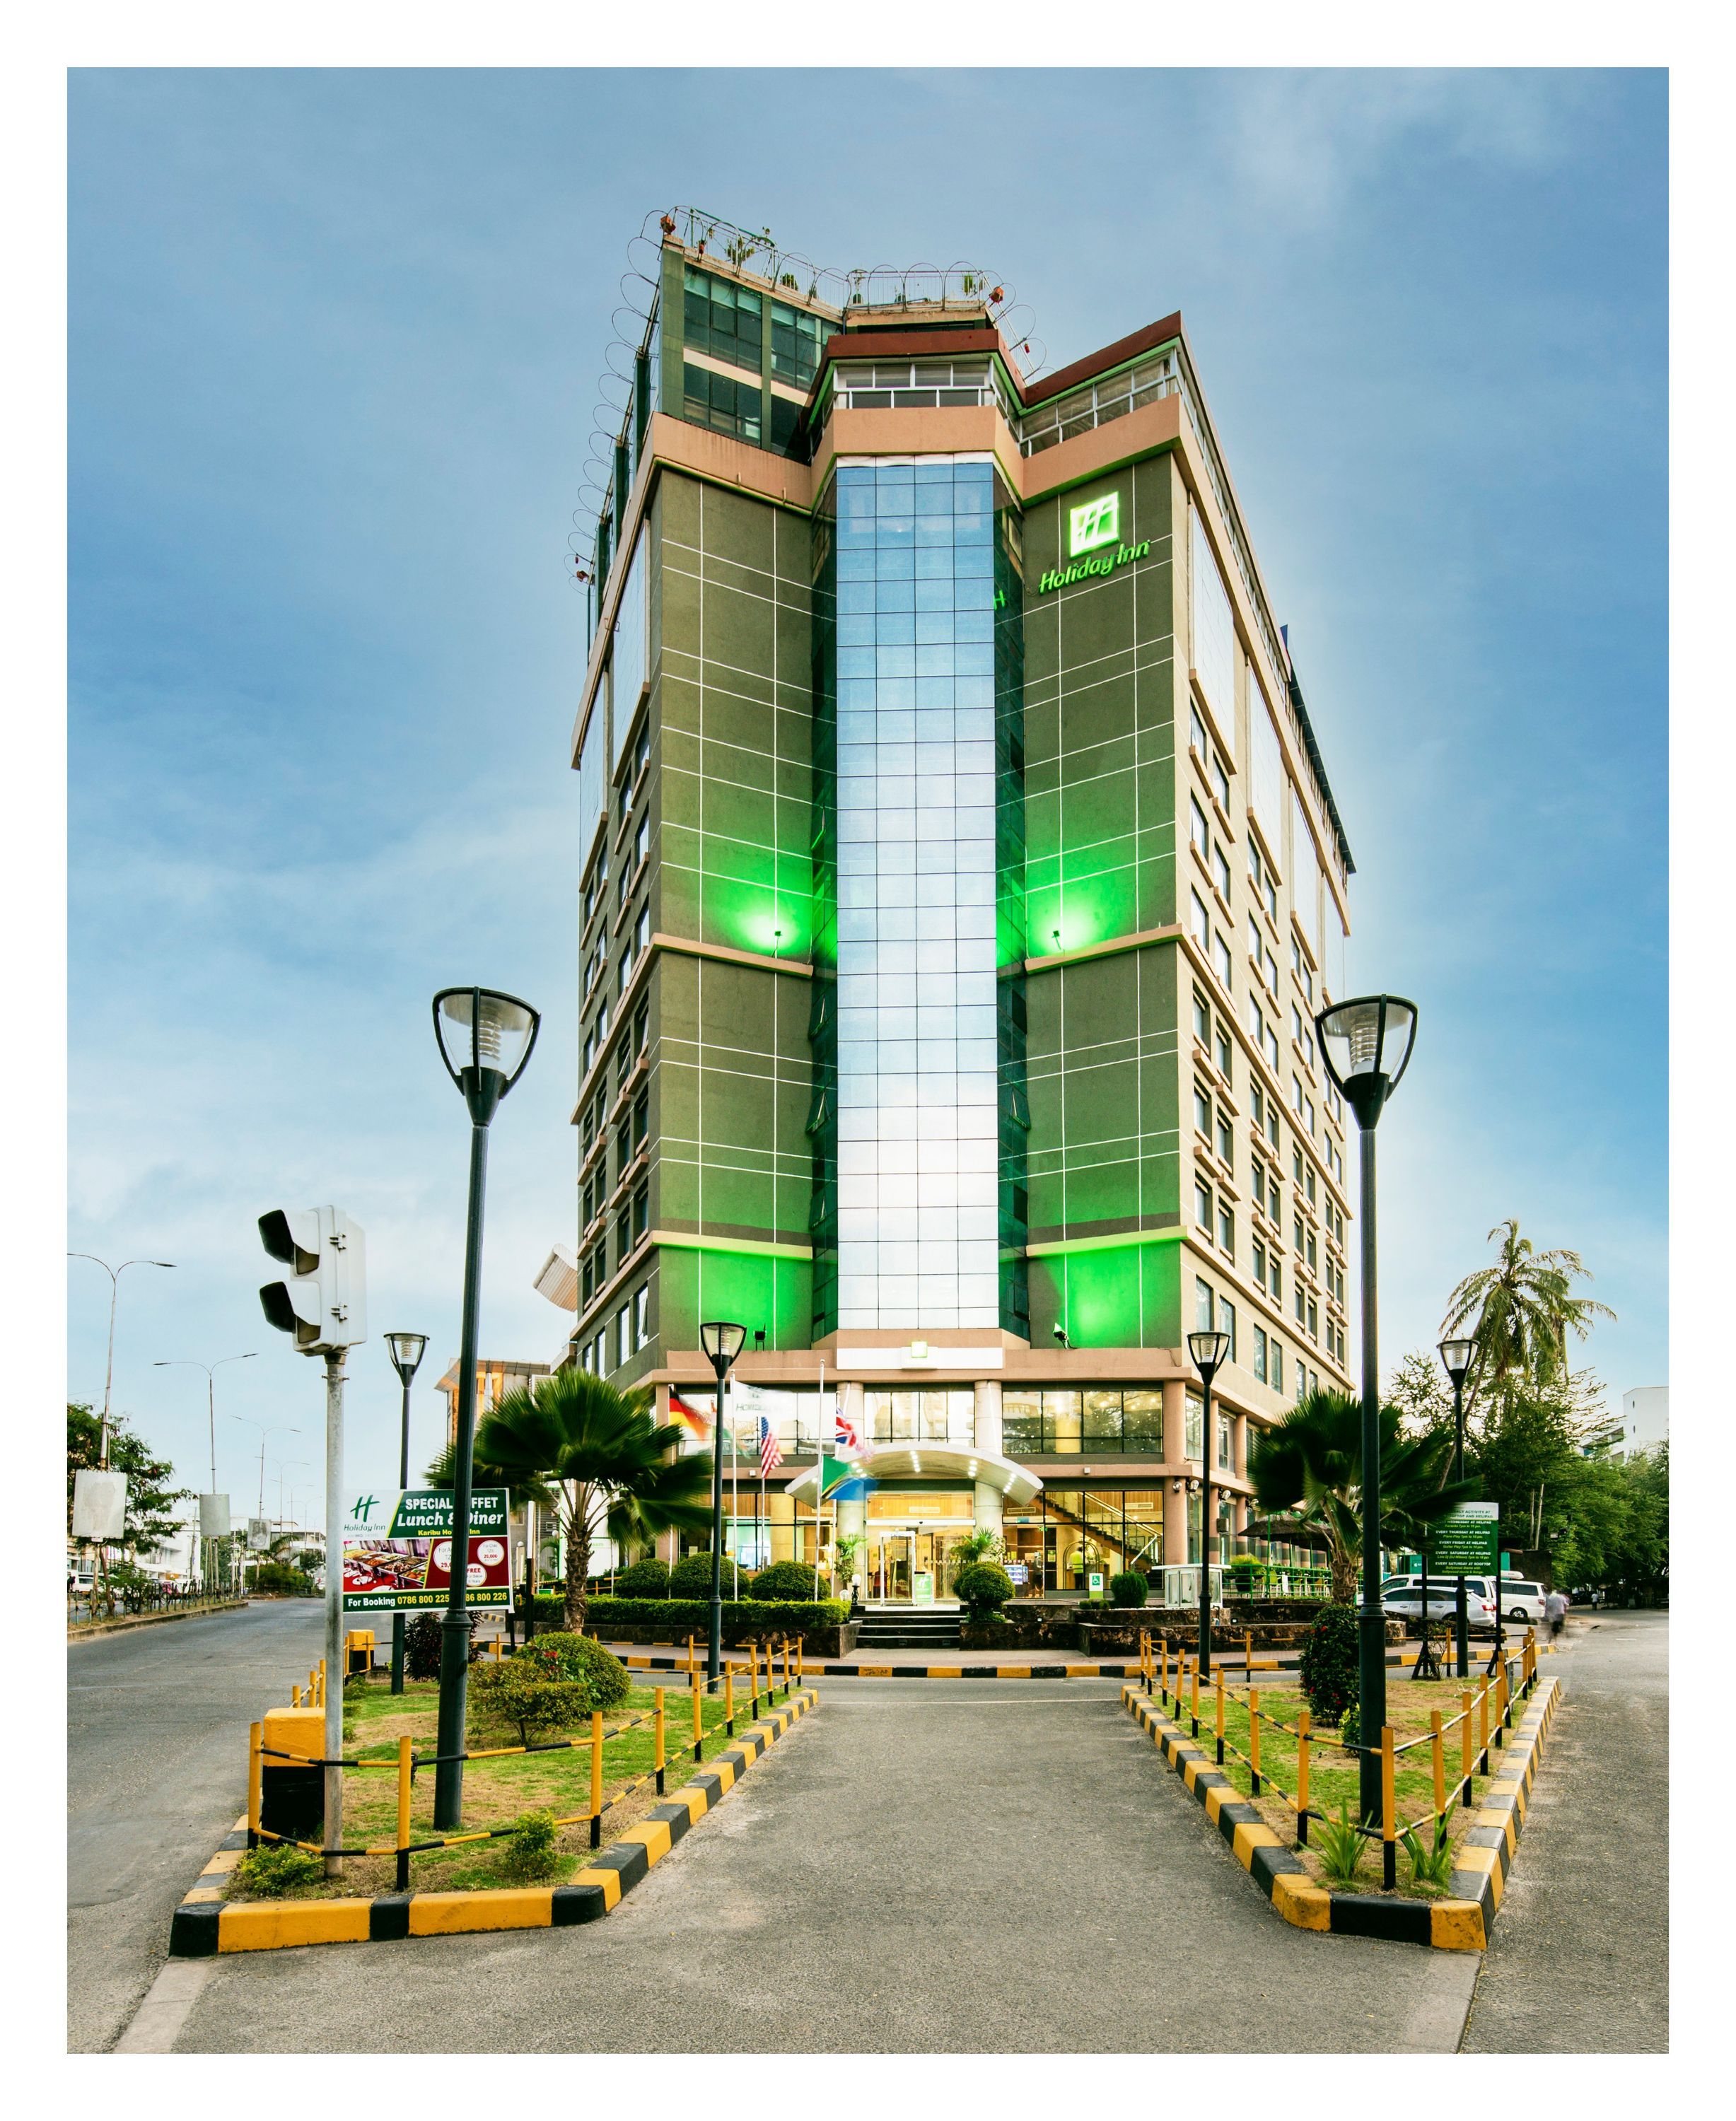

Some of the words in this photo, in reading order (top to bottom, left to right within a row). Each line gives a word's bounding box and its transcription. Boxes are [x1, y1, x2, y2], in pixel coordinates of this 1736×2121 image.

[1039, 554, 1115, 595] Holiday
[1117, 541, 1150, 566] Inn
[405, 1497, 454, 1510] SPECIAL
[471, 1497, 499, 1509] FFET
[397, 1512, 443, 1526] Lunch
[344, 1524, 373, 1532] Holiday
[348, 1598, 361, 1607] For
[363, 1597, 396, 1607] Booking
[397, 1596, 416, 1604] 0786
[419, 1595, 433, 1603] 800
[435, 1594, 450, 1603] 225
[477, 1593, 491, 1601] 800
[493, 1592, 507, 1601] 226
